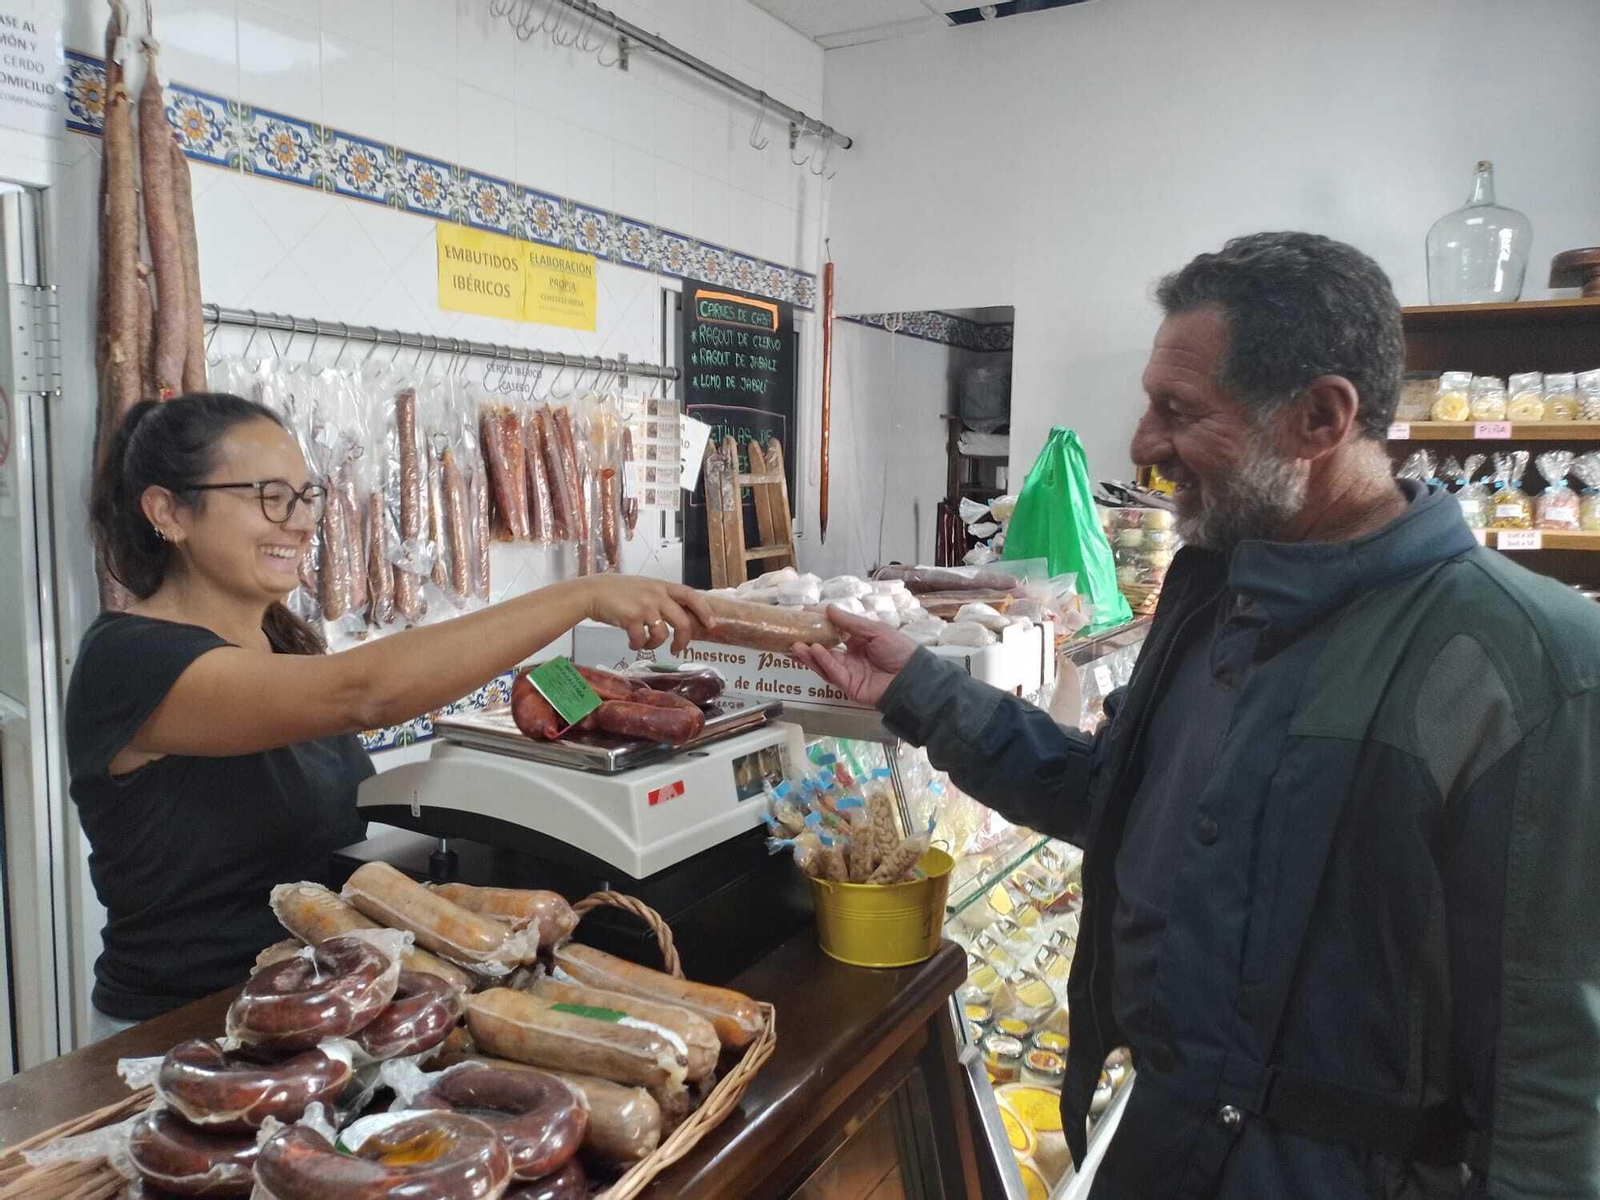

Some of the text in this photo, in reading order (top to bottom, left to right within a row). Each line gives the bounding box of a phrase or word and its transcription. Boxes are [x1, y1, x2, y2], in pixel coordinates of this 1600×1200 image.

[23, 20, 37, 34] AL
[30, 41, 37, 52] Y
[3, 53, 45, 75] CERDO
[444, 244, 519, 272] EMBUTIDOS
[529, 251, 592, 276] ELABORACIÓN
[452, 273, 511, 298] IBÉRICOS
[699, 324, 734, 347] RAGOUT
[737, 331, 748, 345] DE
[699, 348, 731, 366] RAGOUT
[735, 352, 746, 367] DE
[700, 373, 721, 389] LOMO
[725, 376, 736, 389] DE
[734, 675, 750, 690] de
[755, 677, 802, 695] dulces
